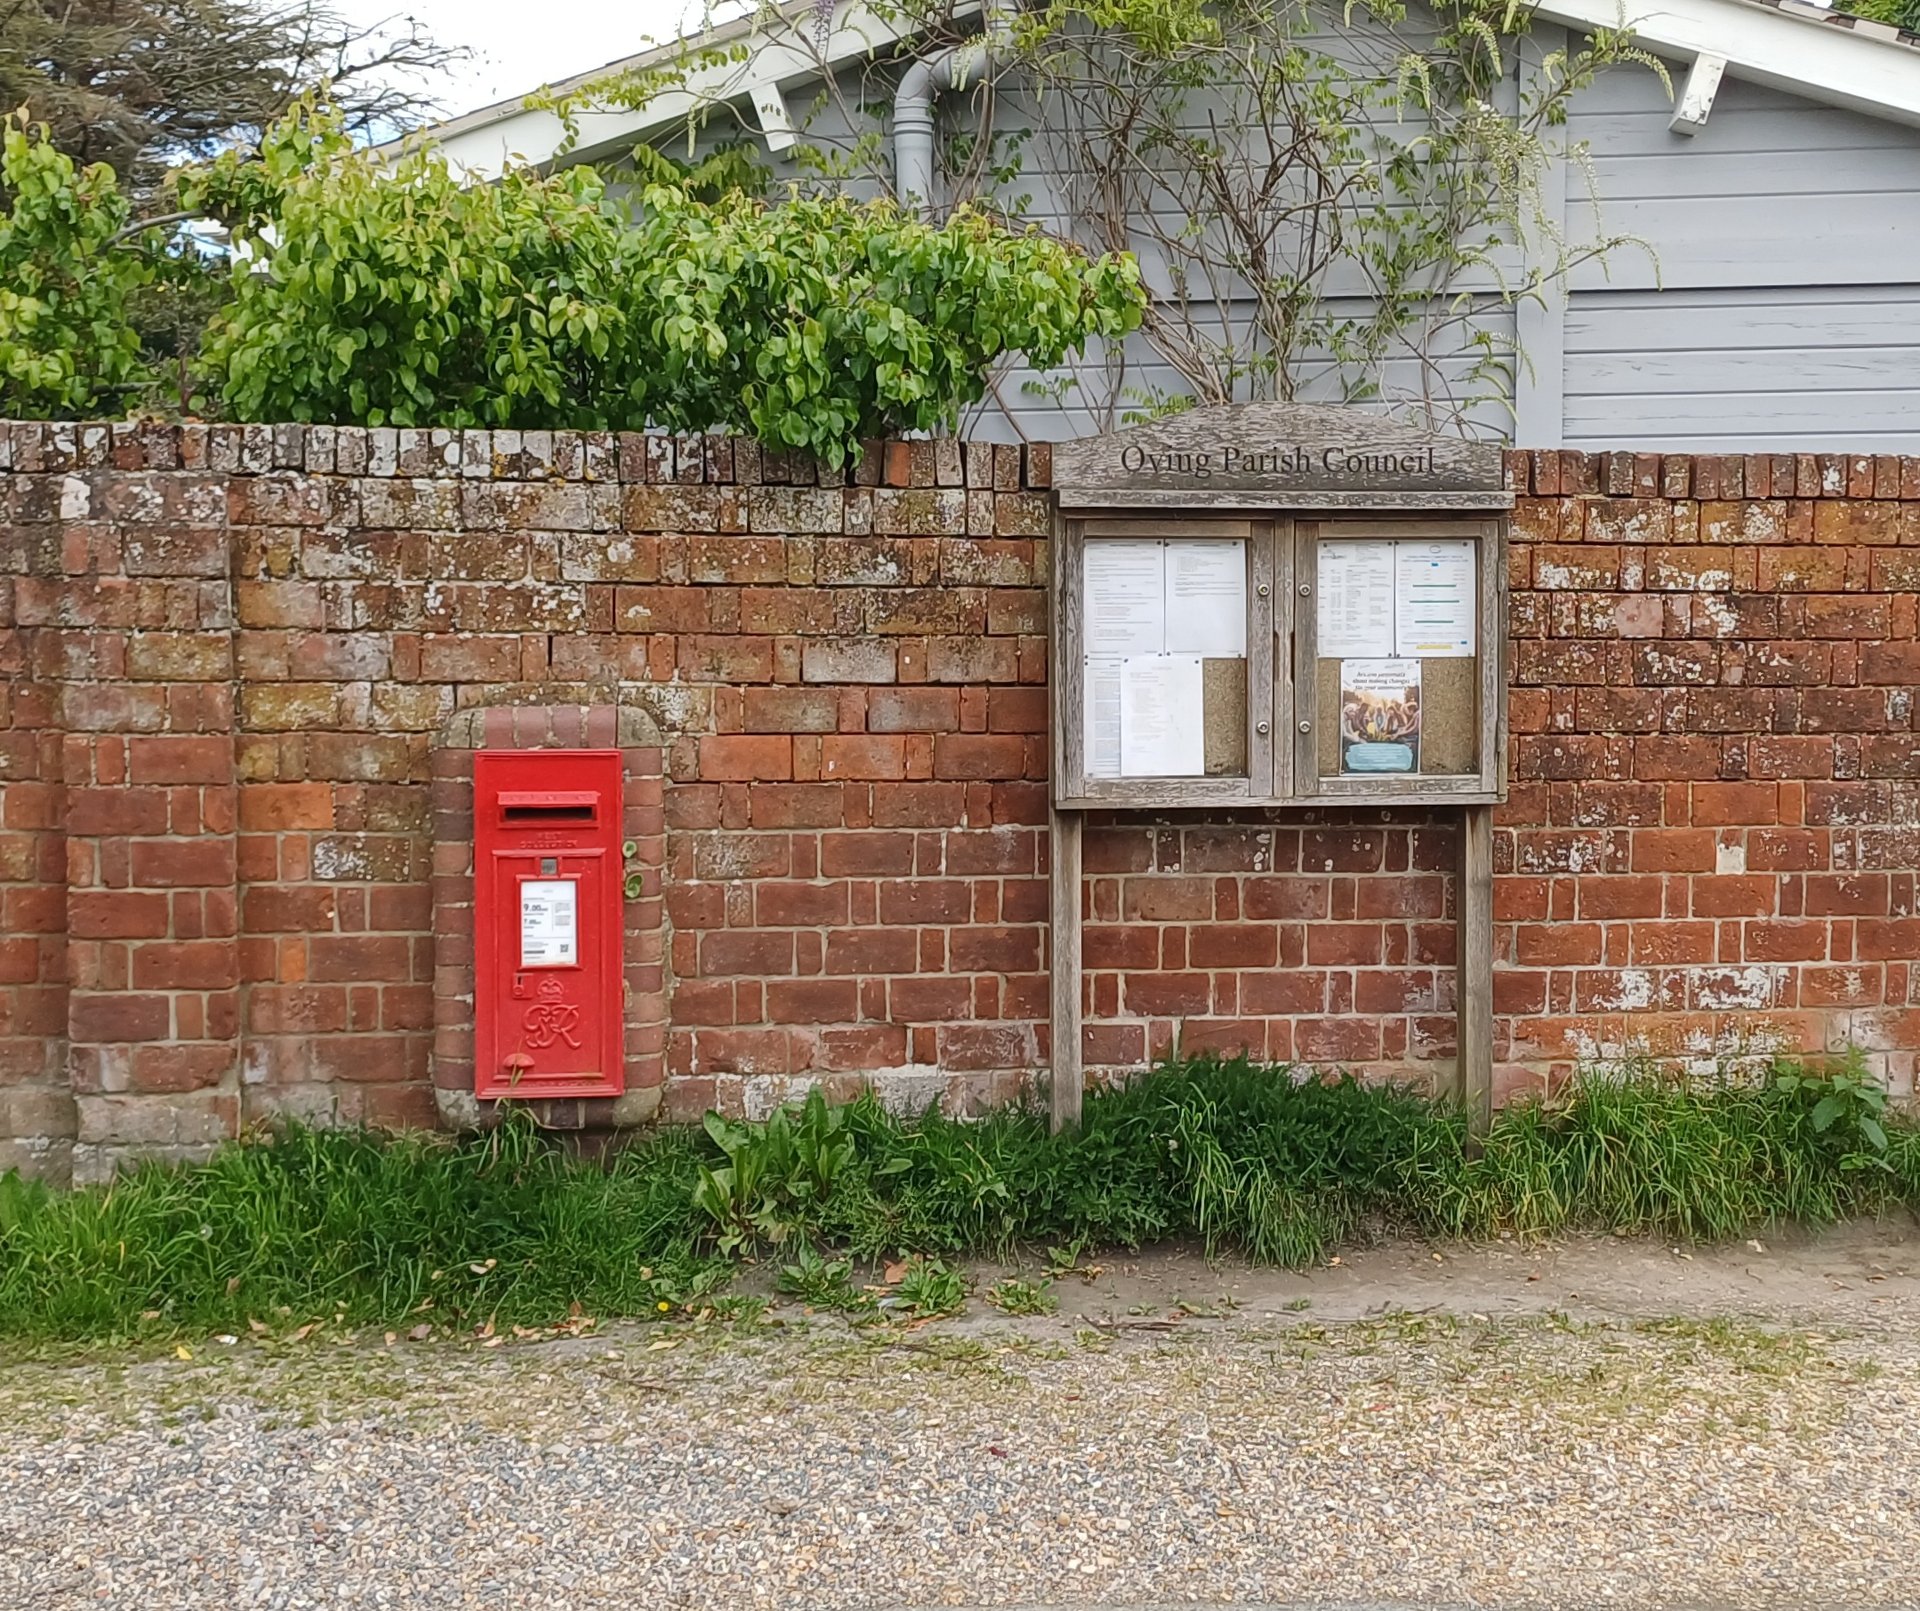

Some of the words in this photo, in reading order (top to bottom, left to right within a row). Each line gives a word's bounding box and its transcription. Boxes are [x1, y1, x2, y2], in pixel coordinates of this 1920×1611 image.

[1120, 445, 1212, 479] Oving
[1220, 445, 1312, 474] Parish
[1322, 446, 1438, 474] Council
